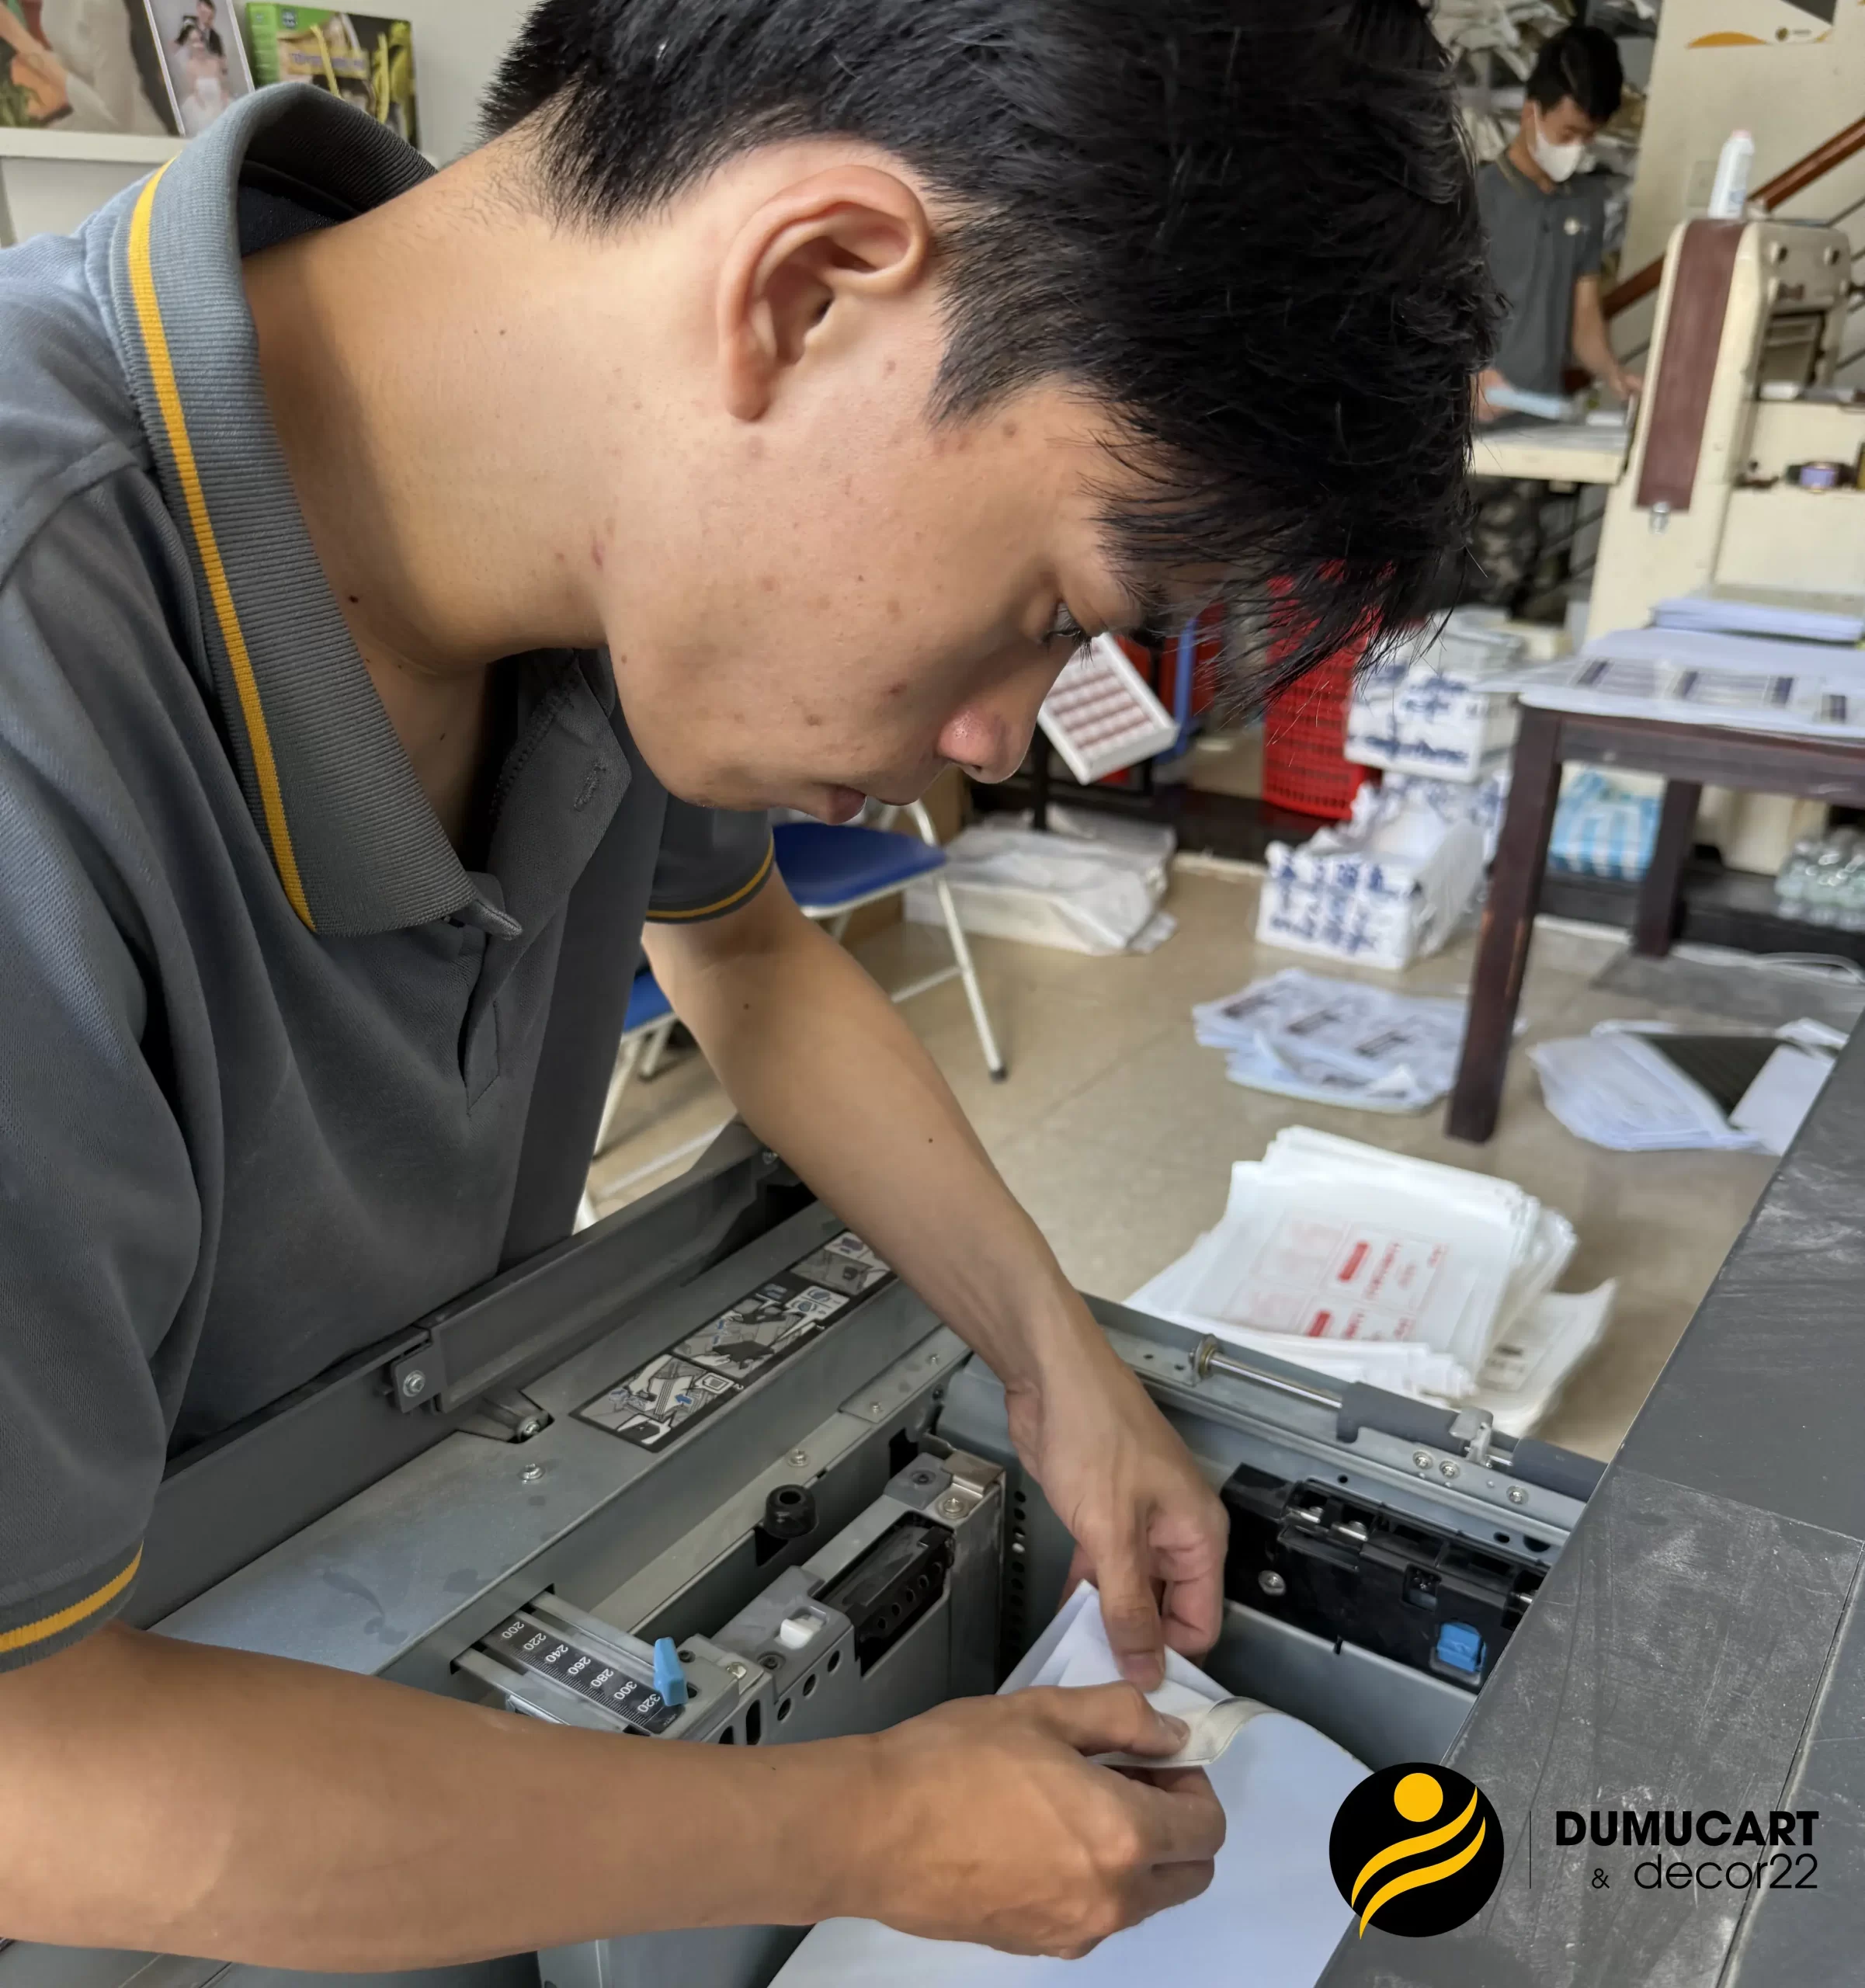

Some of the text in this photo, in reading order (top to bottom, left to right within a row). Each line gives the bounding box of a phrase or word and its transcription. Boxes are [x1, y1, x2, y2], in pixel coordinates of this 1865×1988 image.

[502, 1621, 525, 1639] 200
[523, 1632, 547, 1651] 220
[546, 1644, 569, 1663] 240
[568, 1656, 592, 1675] 260
[590, 1668, 614, 1688] 280
[614, 1680, 637, 1700] 300
[637, 1694, 661, 1713] 320
